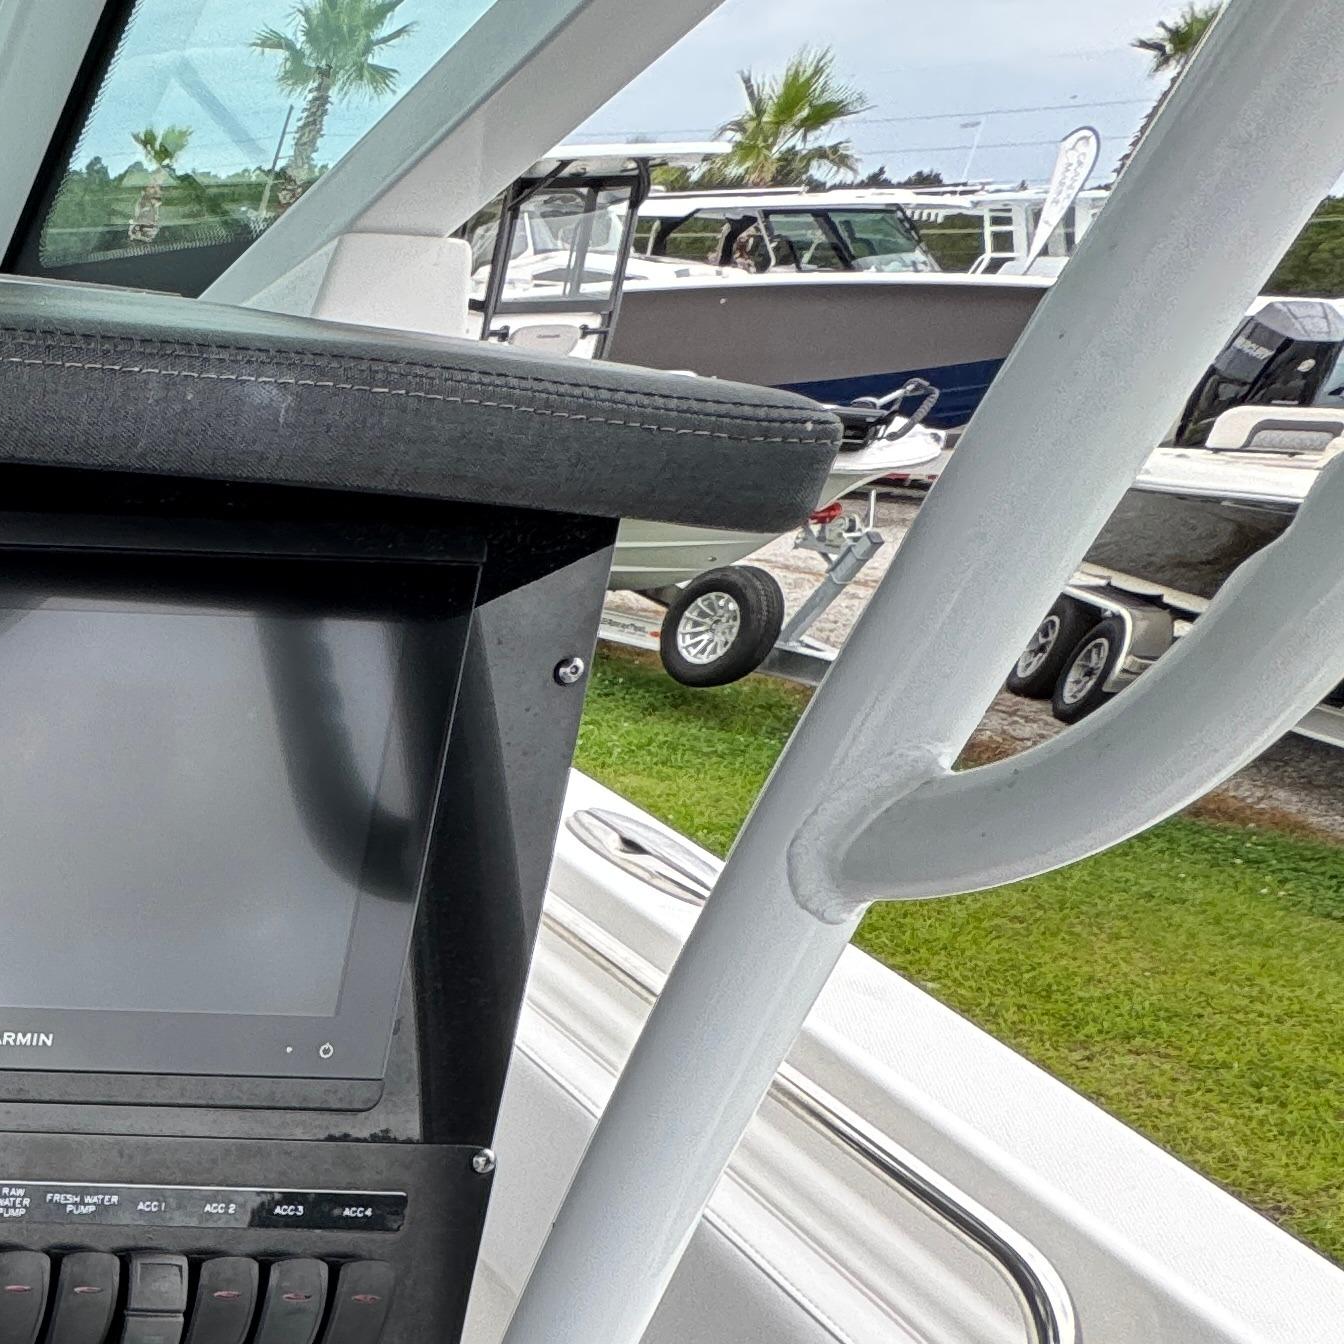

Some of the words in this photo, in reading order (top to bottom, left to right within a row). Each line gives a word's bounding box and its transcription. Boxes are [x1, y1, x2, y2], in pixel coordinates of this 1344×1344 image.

[1, 1187, 25, 1197] RAW
[46, 1193, 81, 1204] FRESH
[84, 1194, 119, 1205] WATER
[66, 1204, 96, 1215] PUMP
[136, 1201, 159, 1212] ACC
[204, 1203, 226, 1213] ACC
[228, 1203, 236, 1213] 2
